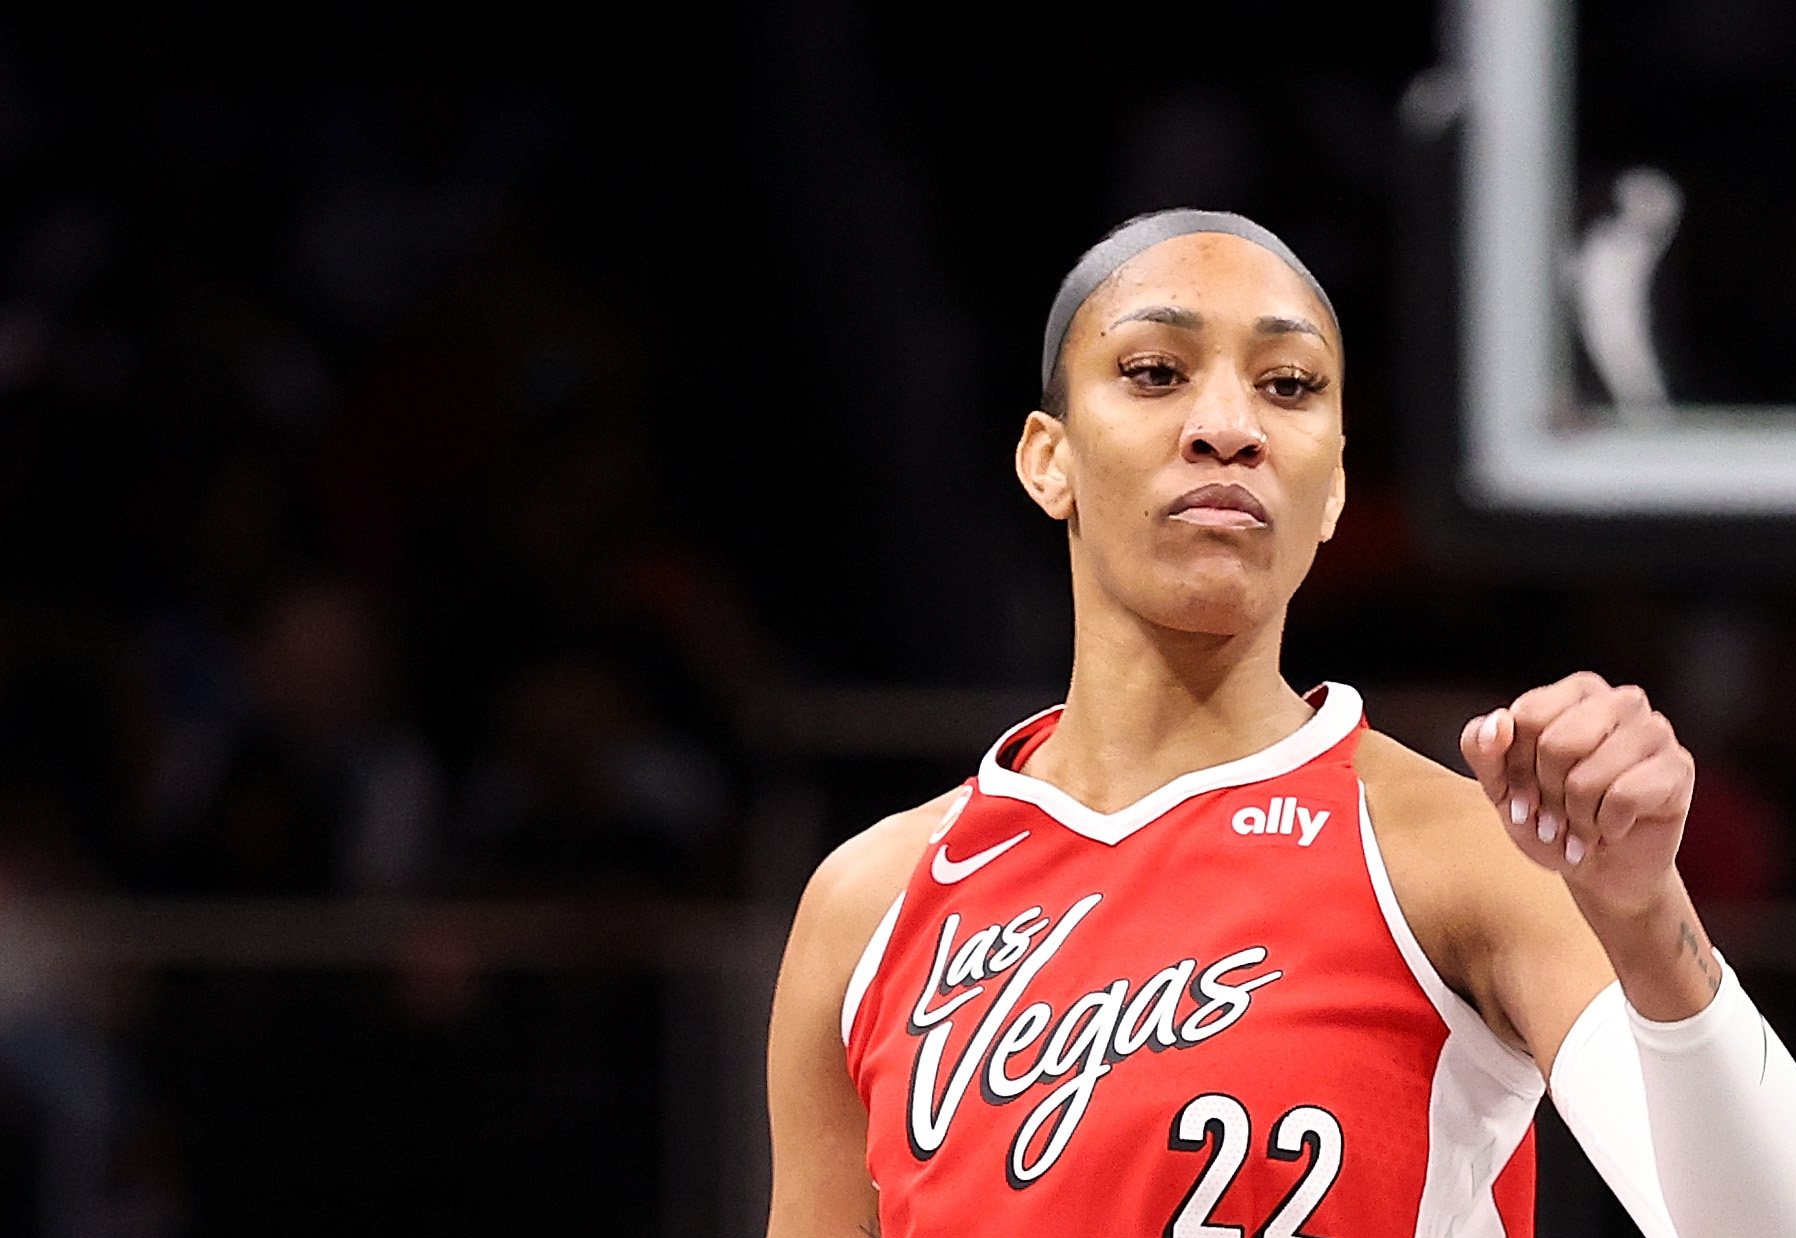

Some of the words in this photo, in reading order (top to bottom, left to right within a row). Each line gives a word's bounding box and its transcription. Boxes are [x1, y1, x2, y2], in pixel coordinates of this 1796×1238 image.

[1231, 796, 1331, 847] ally
[907, 904, 1051, 1037] Las
[907, 892, 1284, 1191] Vegas
